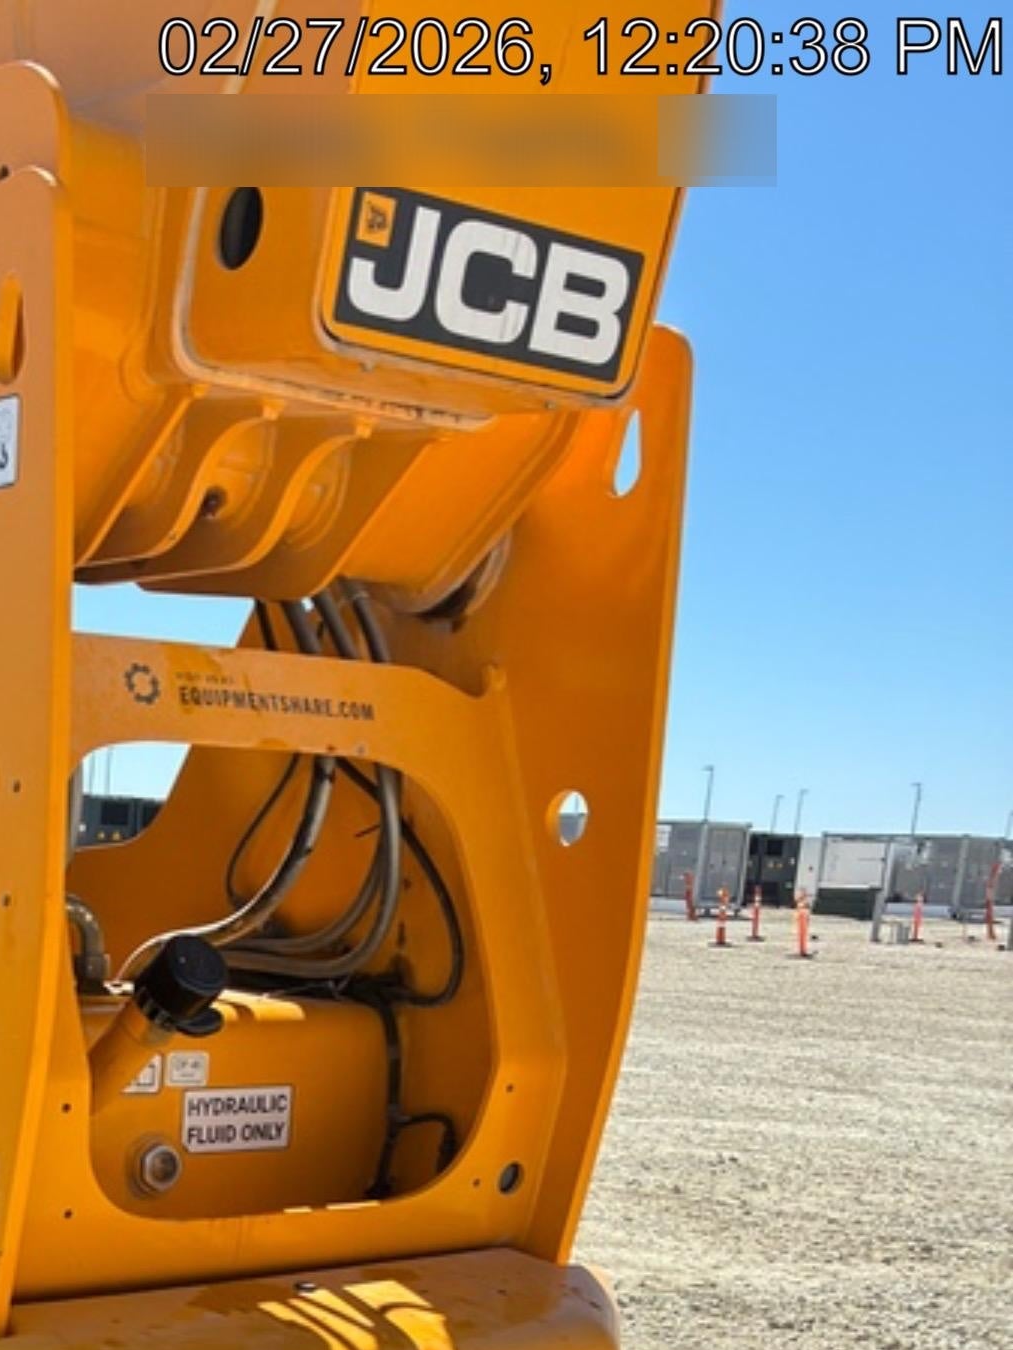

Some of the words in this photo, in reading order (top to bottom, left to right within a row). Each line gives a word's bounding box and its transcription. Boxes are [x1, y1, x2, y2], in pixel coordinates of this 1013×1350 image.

[346, 205, 631, 365] JCB
[179, 685, 376, 721] EQUIPMENTSHARE.COM
[187, 1093, 288, 1117] HYDRAULIC
[187, 1124, 236, 1145] FLUID
[241, 1122, 286, 1141] ONLY
